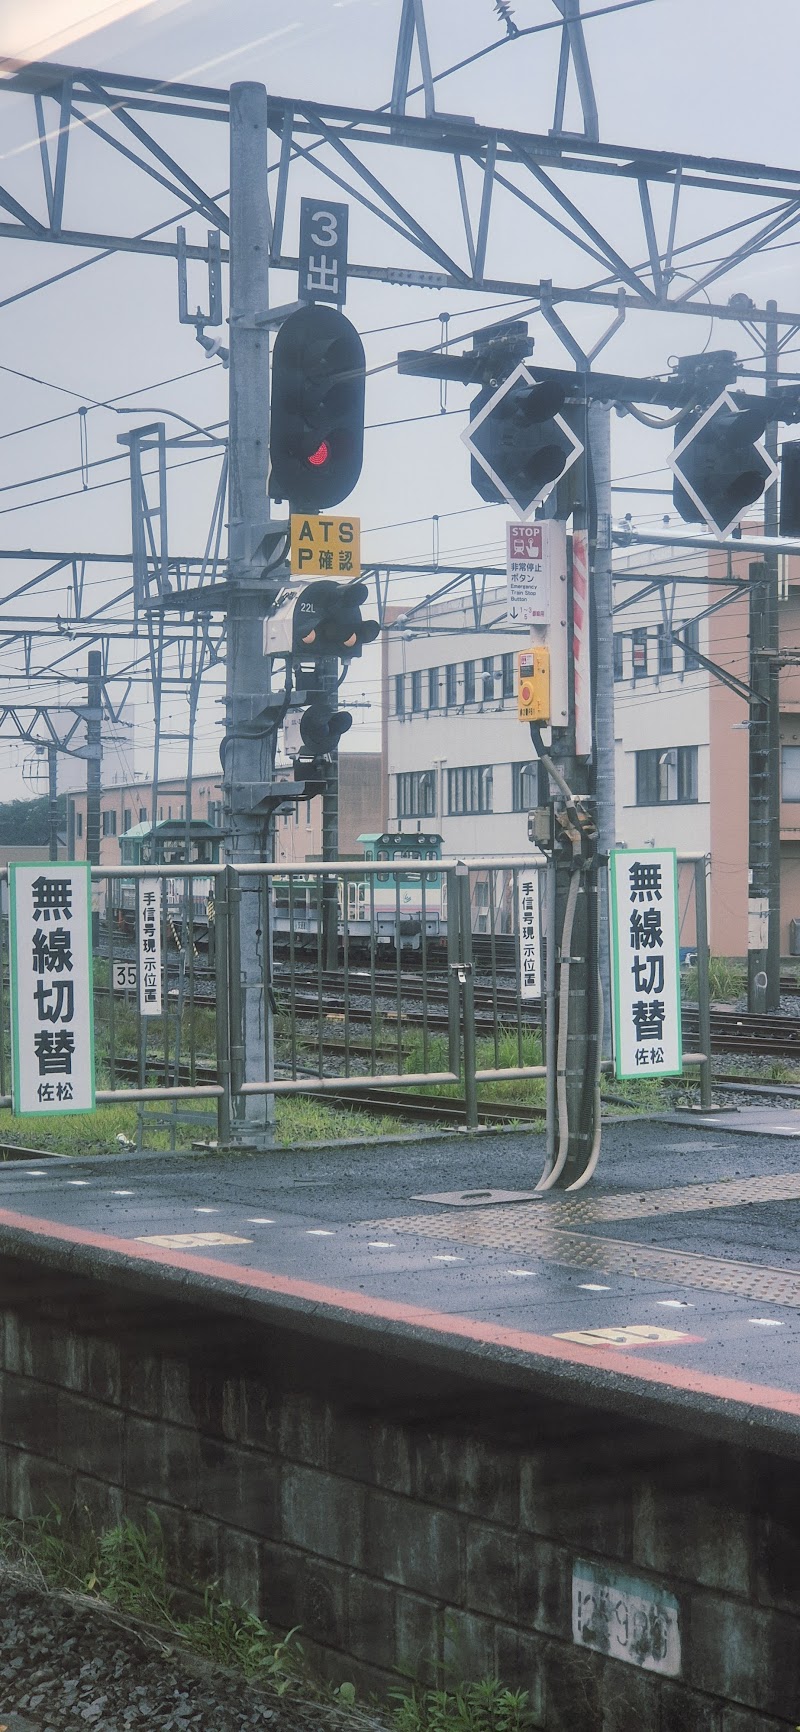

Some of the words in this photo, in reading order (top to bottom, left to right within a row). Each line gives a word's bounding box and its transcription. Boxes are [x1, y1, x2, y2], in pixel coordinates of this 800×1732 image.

[512, 527, 540, 537] STOP
[511, 562, 542, 573] 非常停止
[511, 573, 534, 583] ボタン
[300, 602, 316, 613] 22L
[522, 882, 536, 987] 手信号現示位置
[142, 892, 157, 1003] 手信号現示位置
[628, 861, 666, 1042] 無線切替
[31, 876, 75, 1076] 無線切替
[117, 967, 136, 986] 35
[634, 1047, 664, 1066] 佐松
[37, 1082, 73, 1102] 佐松
